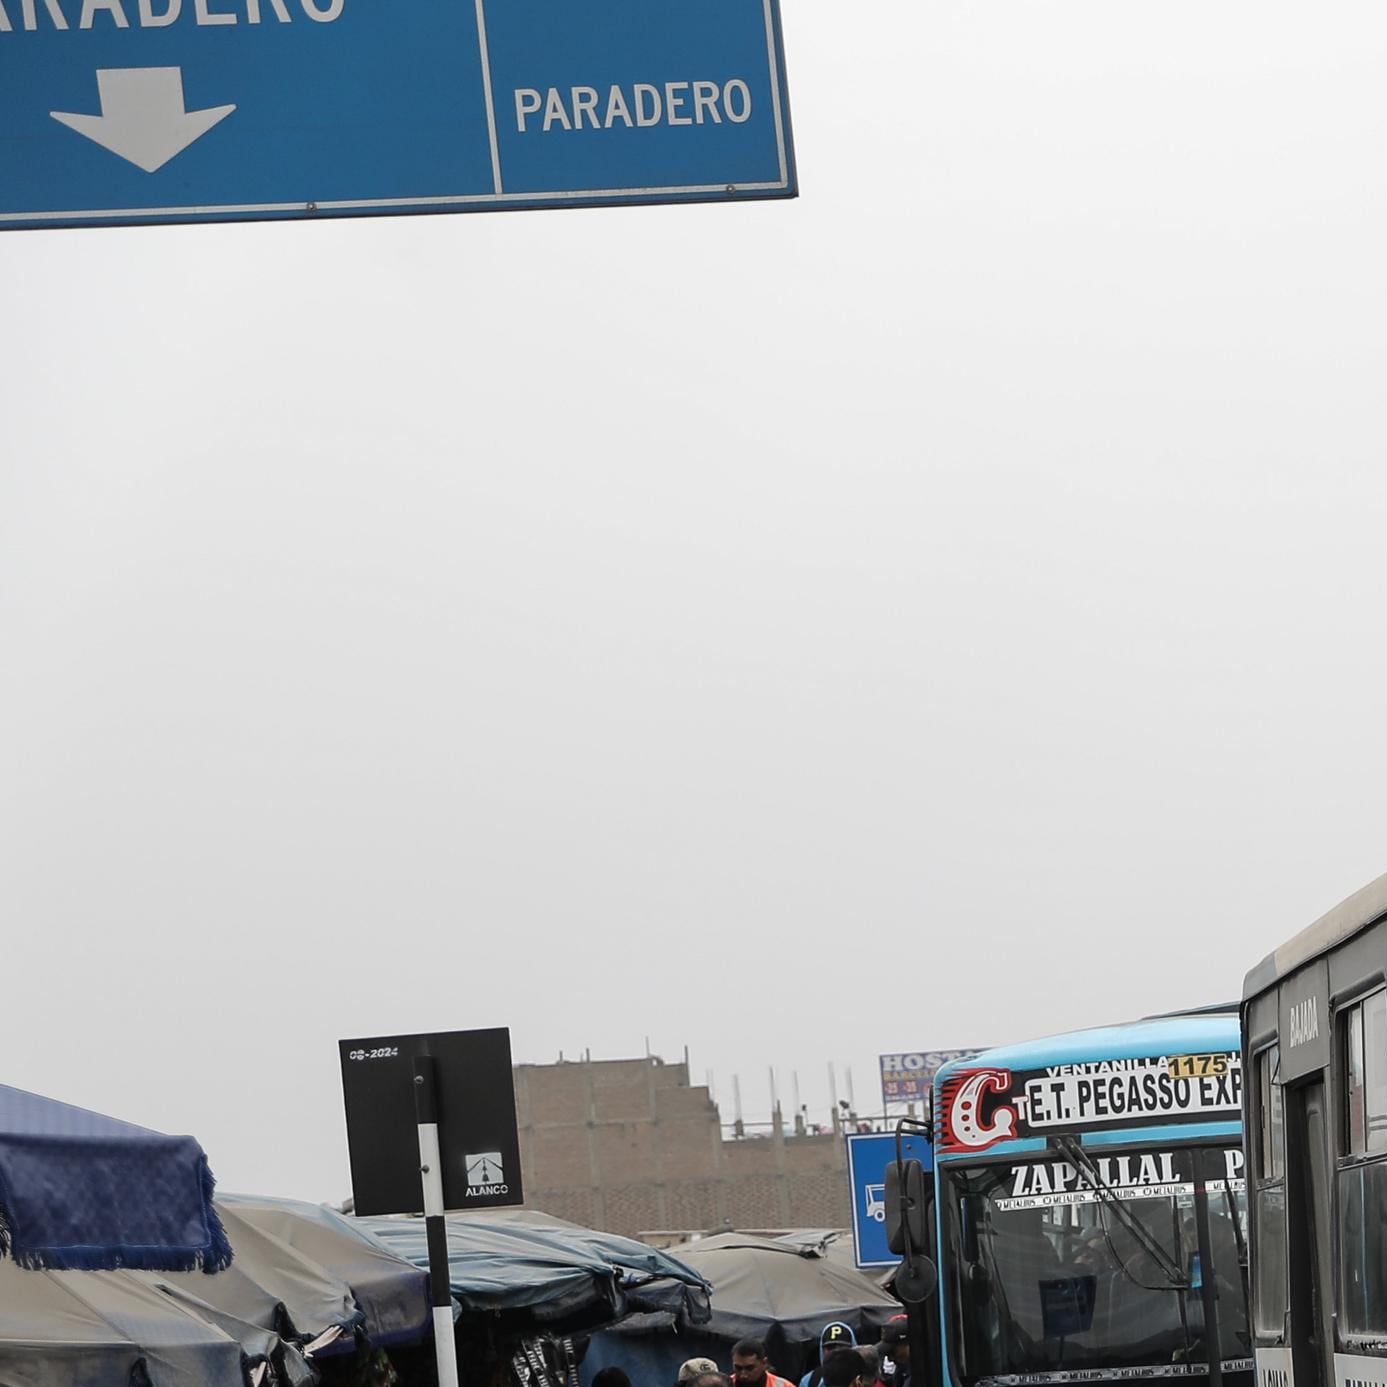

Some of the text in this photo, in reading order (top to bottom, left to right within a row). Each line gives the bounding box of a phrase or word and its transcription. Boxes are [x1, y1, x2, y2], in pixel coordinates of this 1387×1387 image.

[514, 79, 752, 132] PARADERO
[1290, 995, 1319, 1048] BAJADA
[1047, 1056, 1168, 1078] VENTANILLA
[1169, 1055, 1227, 1077] 1175
[1029, 1082, 1070, 1122] E.T.
[1078, 1072, 1191, 1117] PEGASSO
[465, 1184, 509, 1197] ALANCO
[1011, 1152, 1180, 1197] ZAPALLAL
[831, 1326, 842, 1339] P
